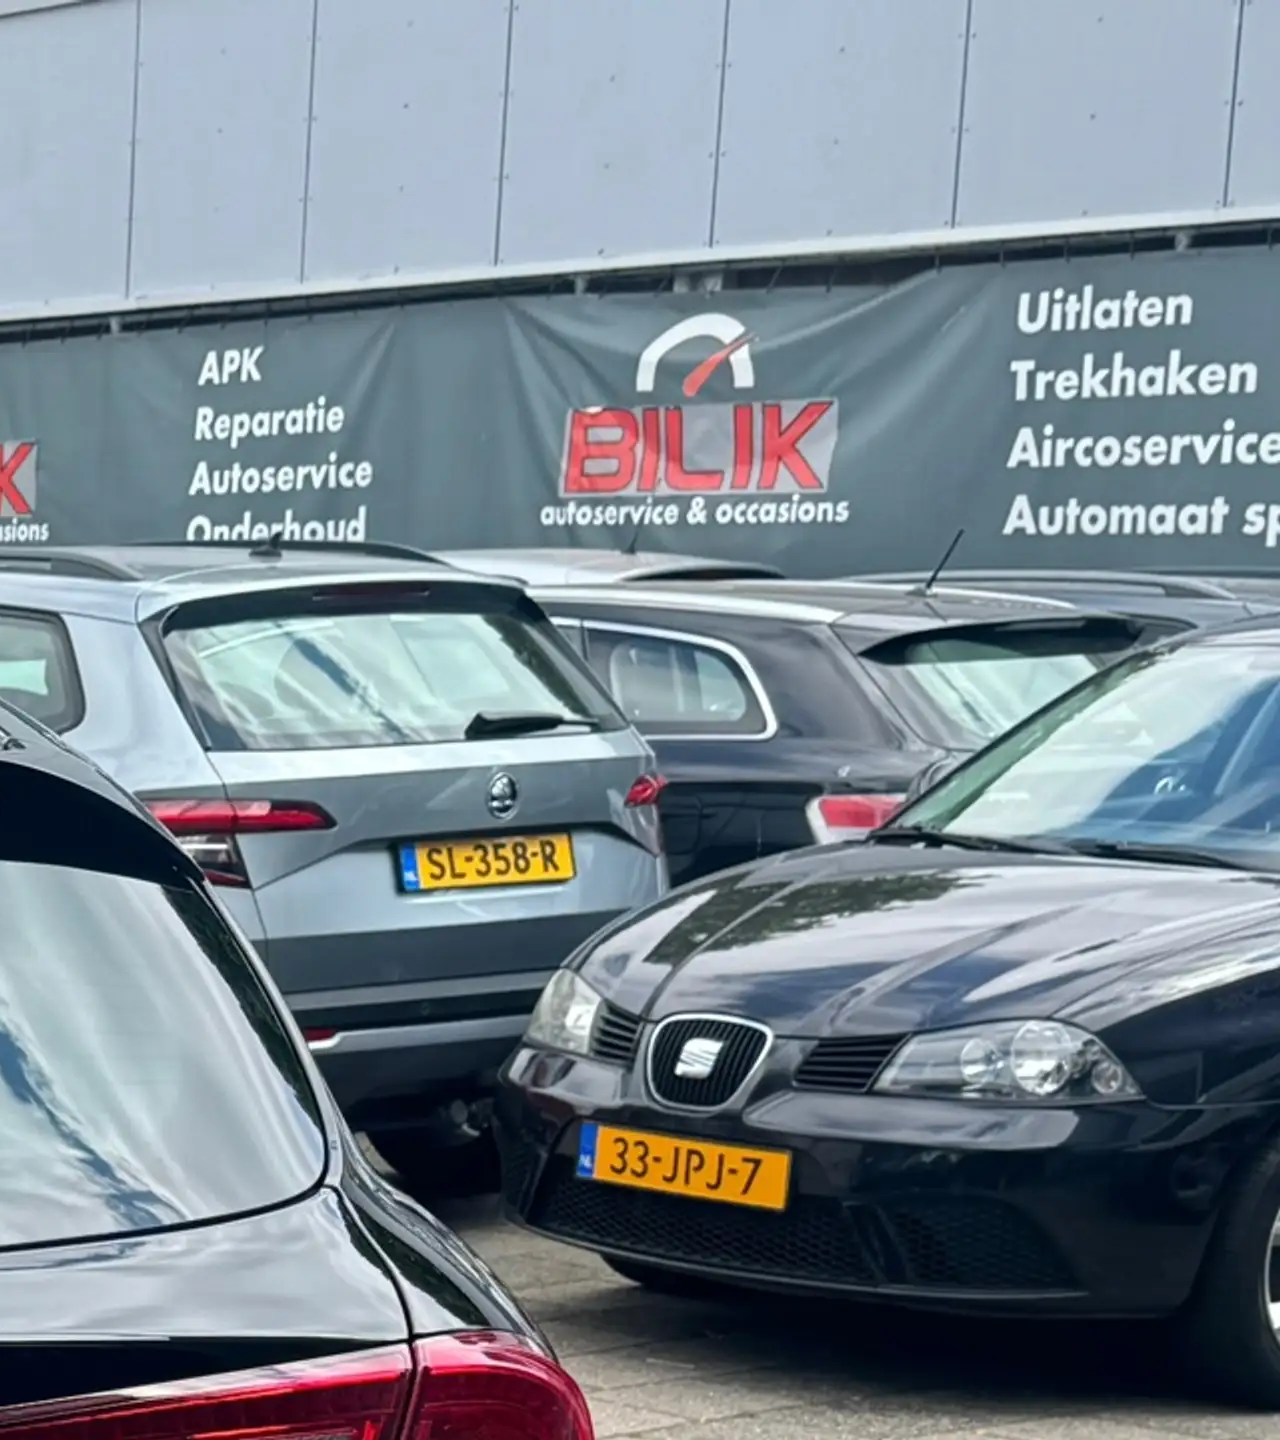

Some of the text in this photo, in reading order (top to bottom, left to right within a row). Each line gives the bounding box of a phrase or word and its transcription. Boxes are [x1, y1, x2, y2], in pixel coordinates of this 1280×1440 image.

[1014, 285, 1195, 334] Uitlaten
[197, 345, 263, 386] APK
[1009, 348, 1259, 401] Trekhaken
[193, 396, 345, 447] Reparatie
[1005, 417, 1280, 469] Aircoservice
[563, 400, 836, 493] BILIK
[188, 453, 374, 496] Autoservice
[186, 504, 367, 541] Onderhoud
[540, 494, 851, 526] autoservice & occasions
[1001, 494, 1230, 536] Automaat
[425, 839, 560, 881] SL-358-R
[609, 1136, 764, 1196] 33-JPJ-7
